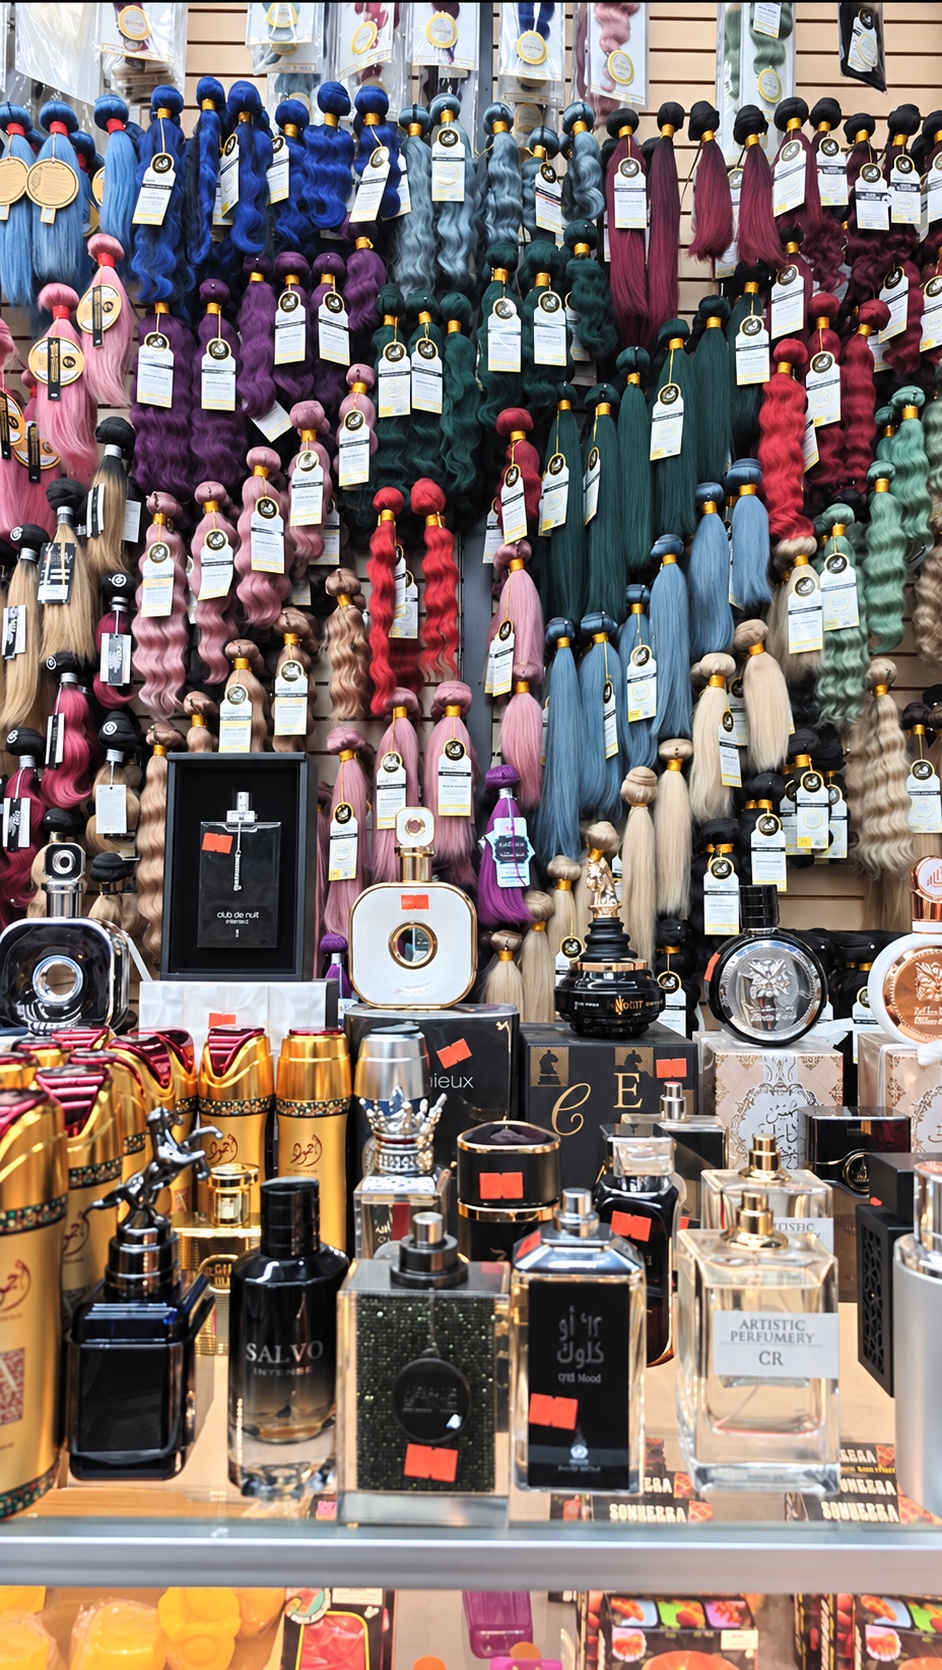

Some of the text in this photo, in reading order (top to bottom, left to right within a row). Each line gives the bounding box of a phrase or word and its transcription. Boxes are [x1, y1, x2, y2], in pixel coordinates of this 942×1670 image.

[613, 1072, 643, 1109] E
[739, 1319, 806, 1331] ARTISTIC
[730, 1331, 815, 1344] PERFUMERY
[246, 1340, 324, 1363] SALVO
[758, 1350, 784, 1366] CR
[253, 1366, 313, 1377] INTENSE
